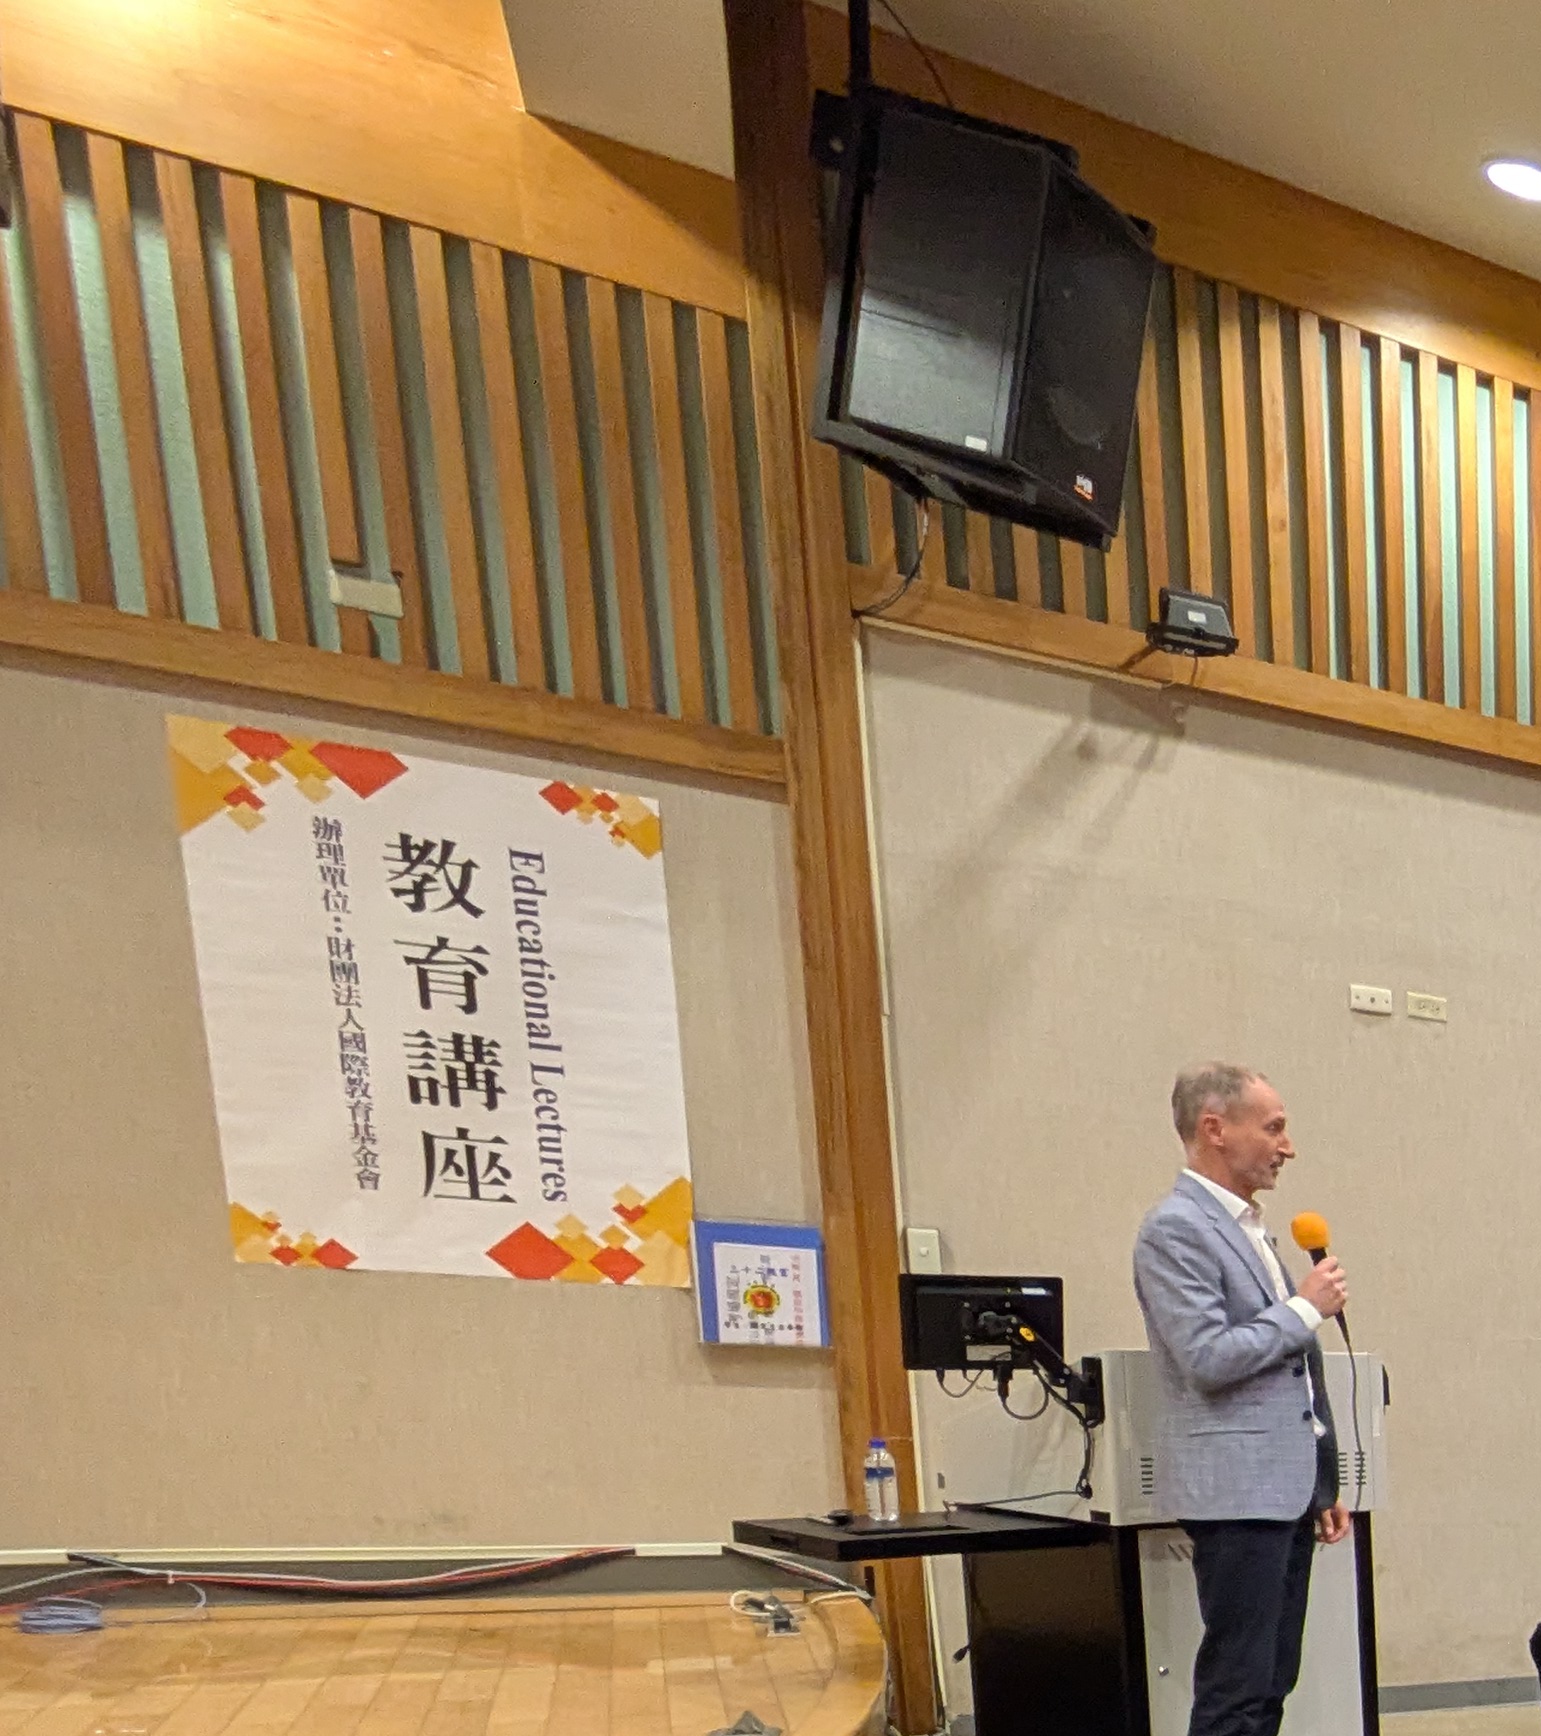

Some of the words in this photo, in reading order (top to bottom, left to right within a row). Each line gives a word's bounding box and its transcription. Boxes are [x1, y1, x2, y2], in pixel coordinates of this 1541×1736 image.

[382, 832, 517, 1205] 教育講座
[507, 846, 564, 1052] Educational
[528, 1059, 568, 1203] Lectures
